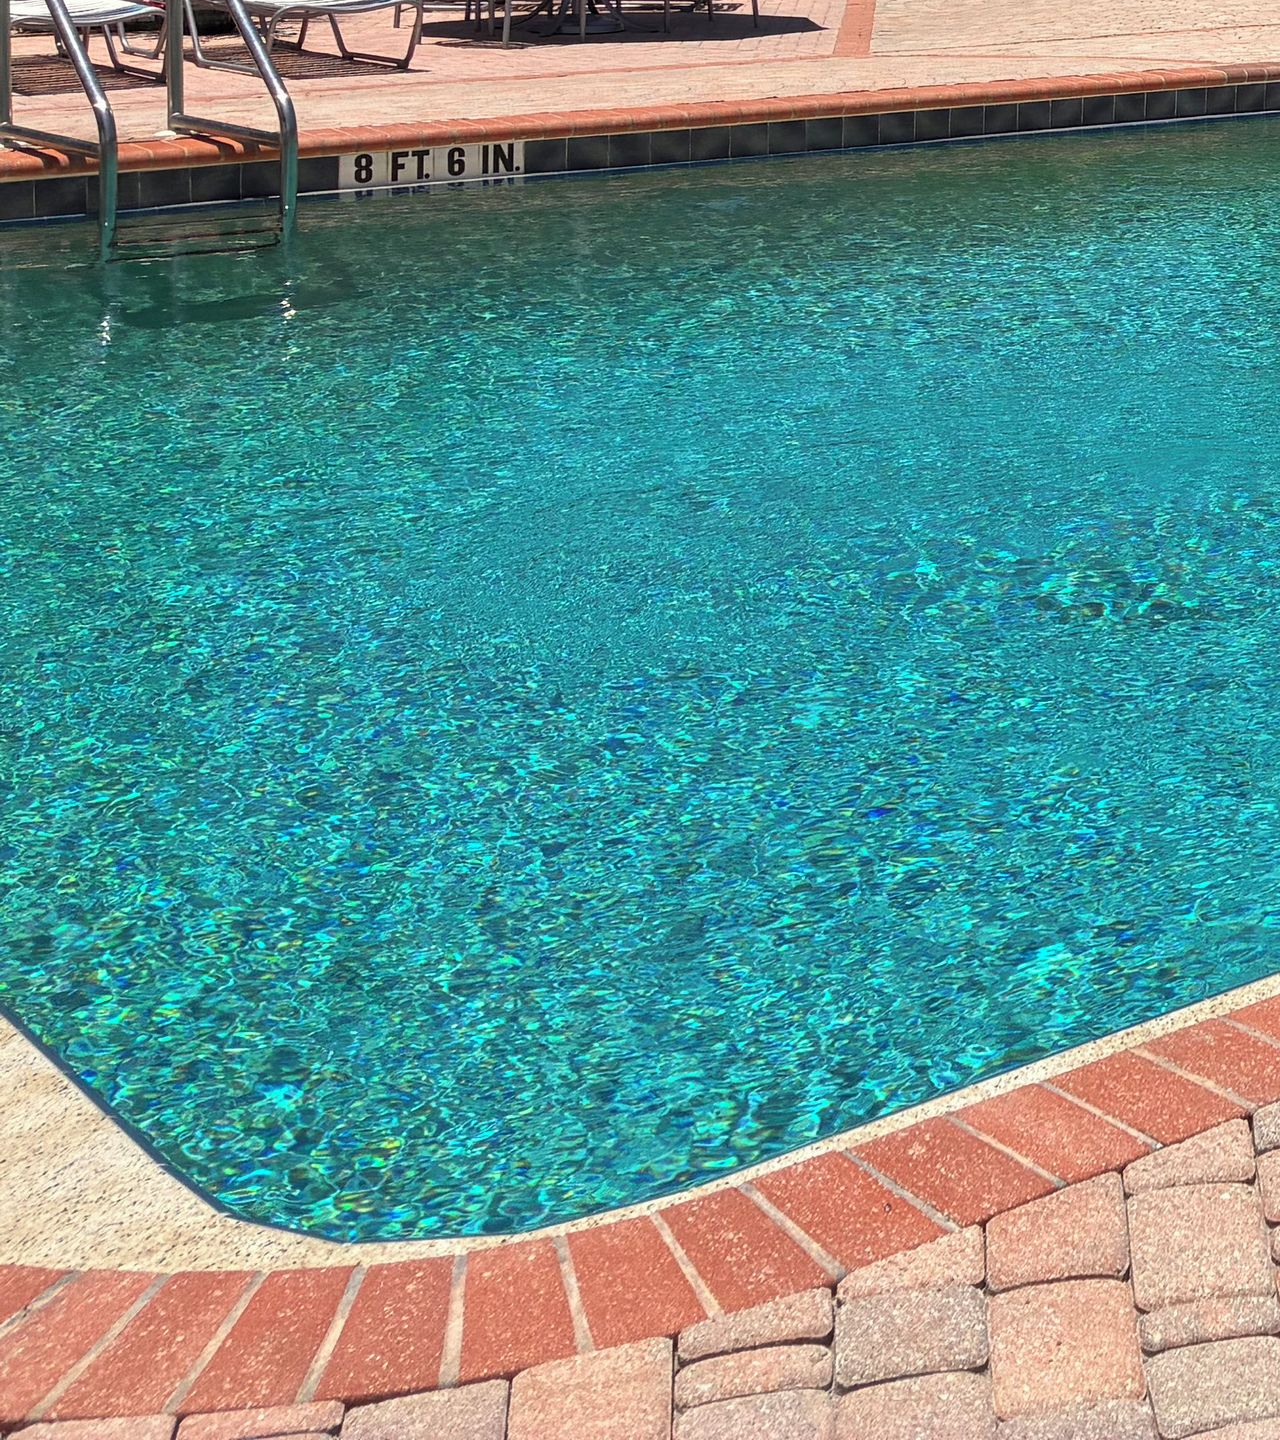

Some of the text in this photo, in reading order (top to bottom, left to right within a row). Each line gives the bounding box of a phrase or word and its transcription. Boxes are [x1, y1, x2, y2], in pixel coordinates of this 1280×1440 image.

[354, 142, 521, 184] 8 FT. 6 IN.
